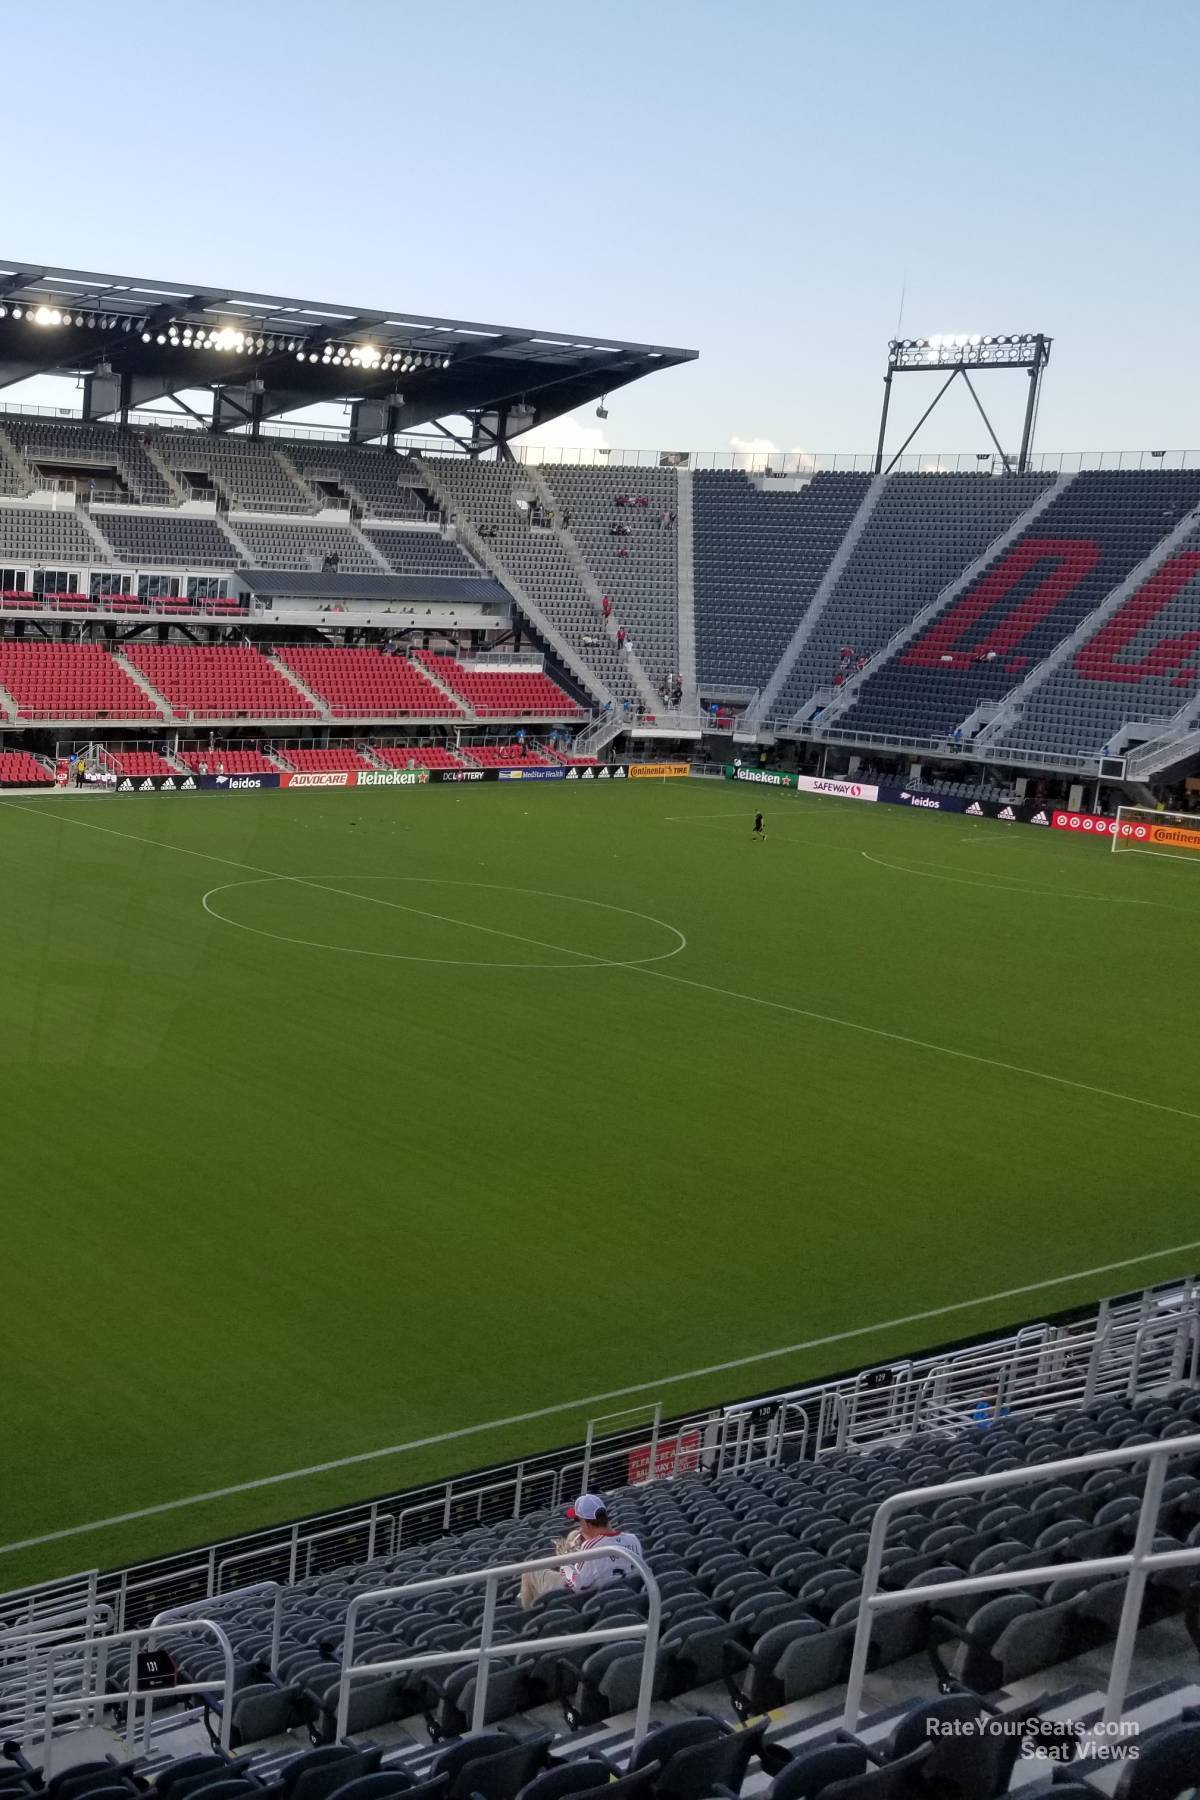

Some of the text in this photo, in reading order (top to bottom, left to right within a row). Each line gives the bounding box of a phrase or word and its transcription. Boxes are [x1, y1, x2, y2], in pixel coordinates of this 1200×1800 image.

[229, 777, 261, 789] leidos
[290, 773, 348, 787] ADVOCARE
[357, 771, 416, 786] Heineken
[812, 780, 850, 795] SAFEWAY
[911, 795, 940, 809] leidos
[874, 1373, 886, 1383] 129
[758, 1406, 771, 1417] 130
[146, 1661, 158, 1672] 131
